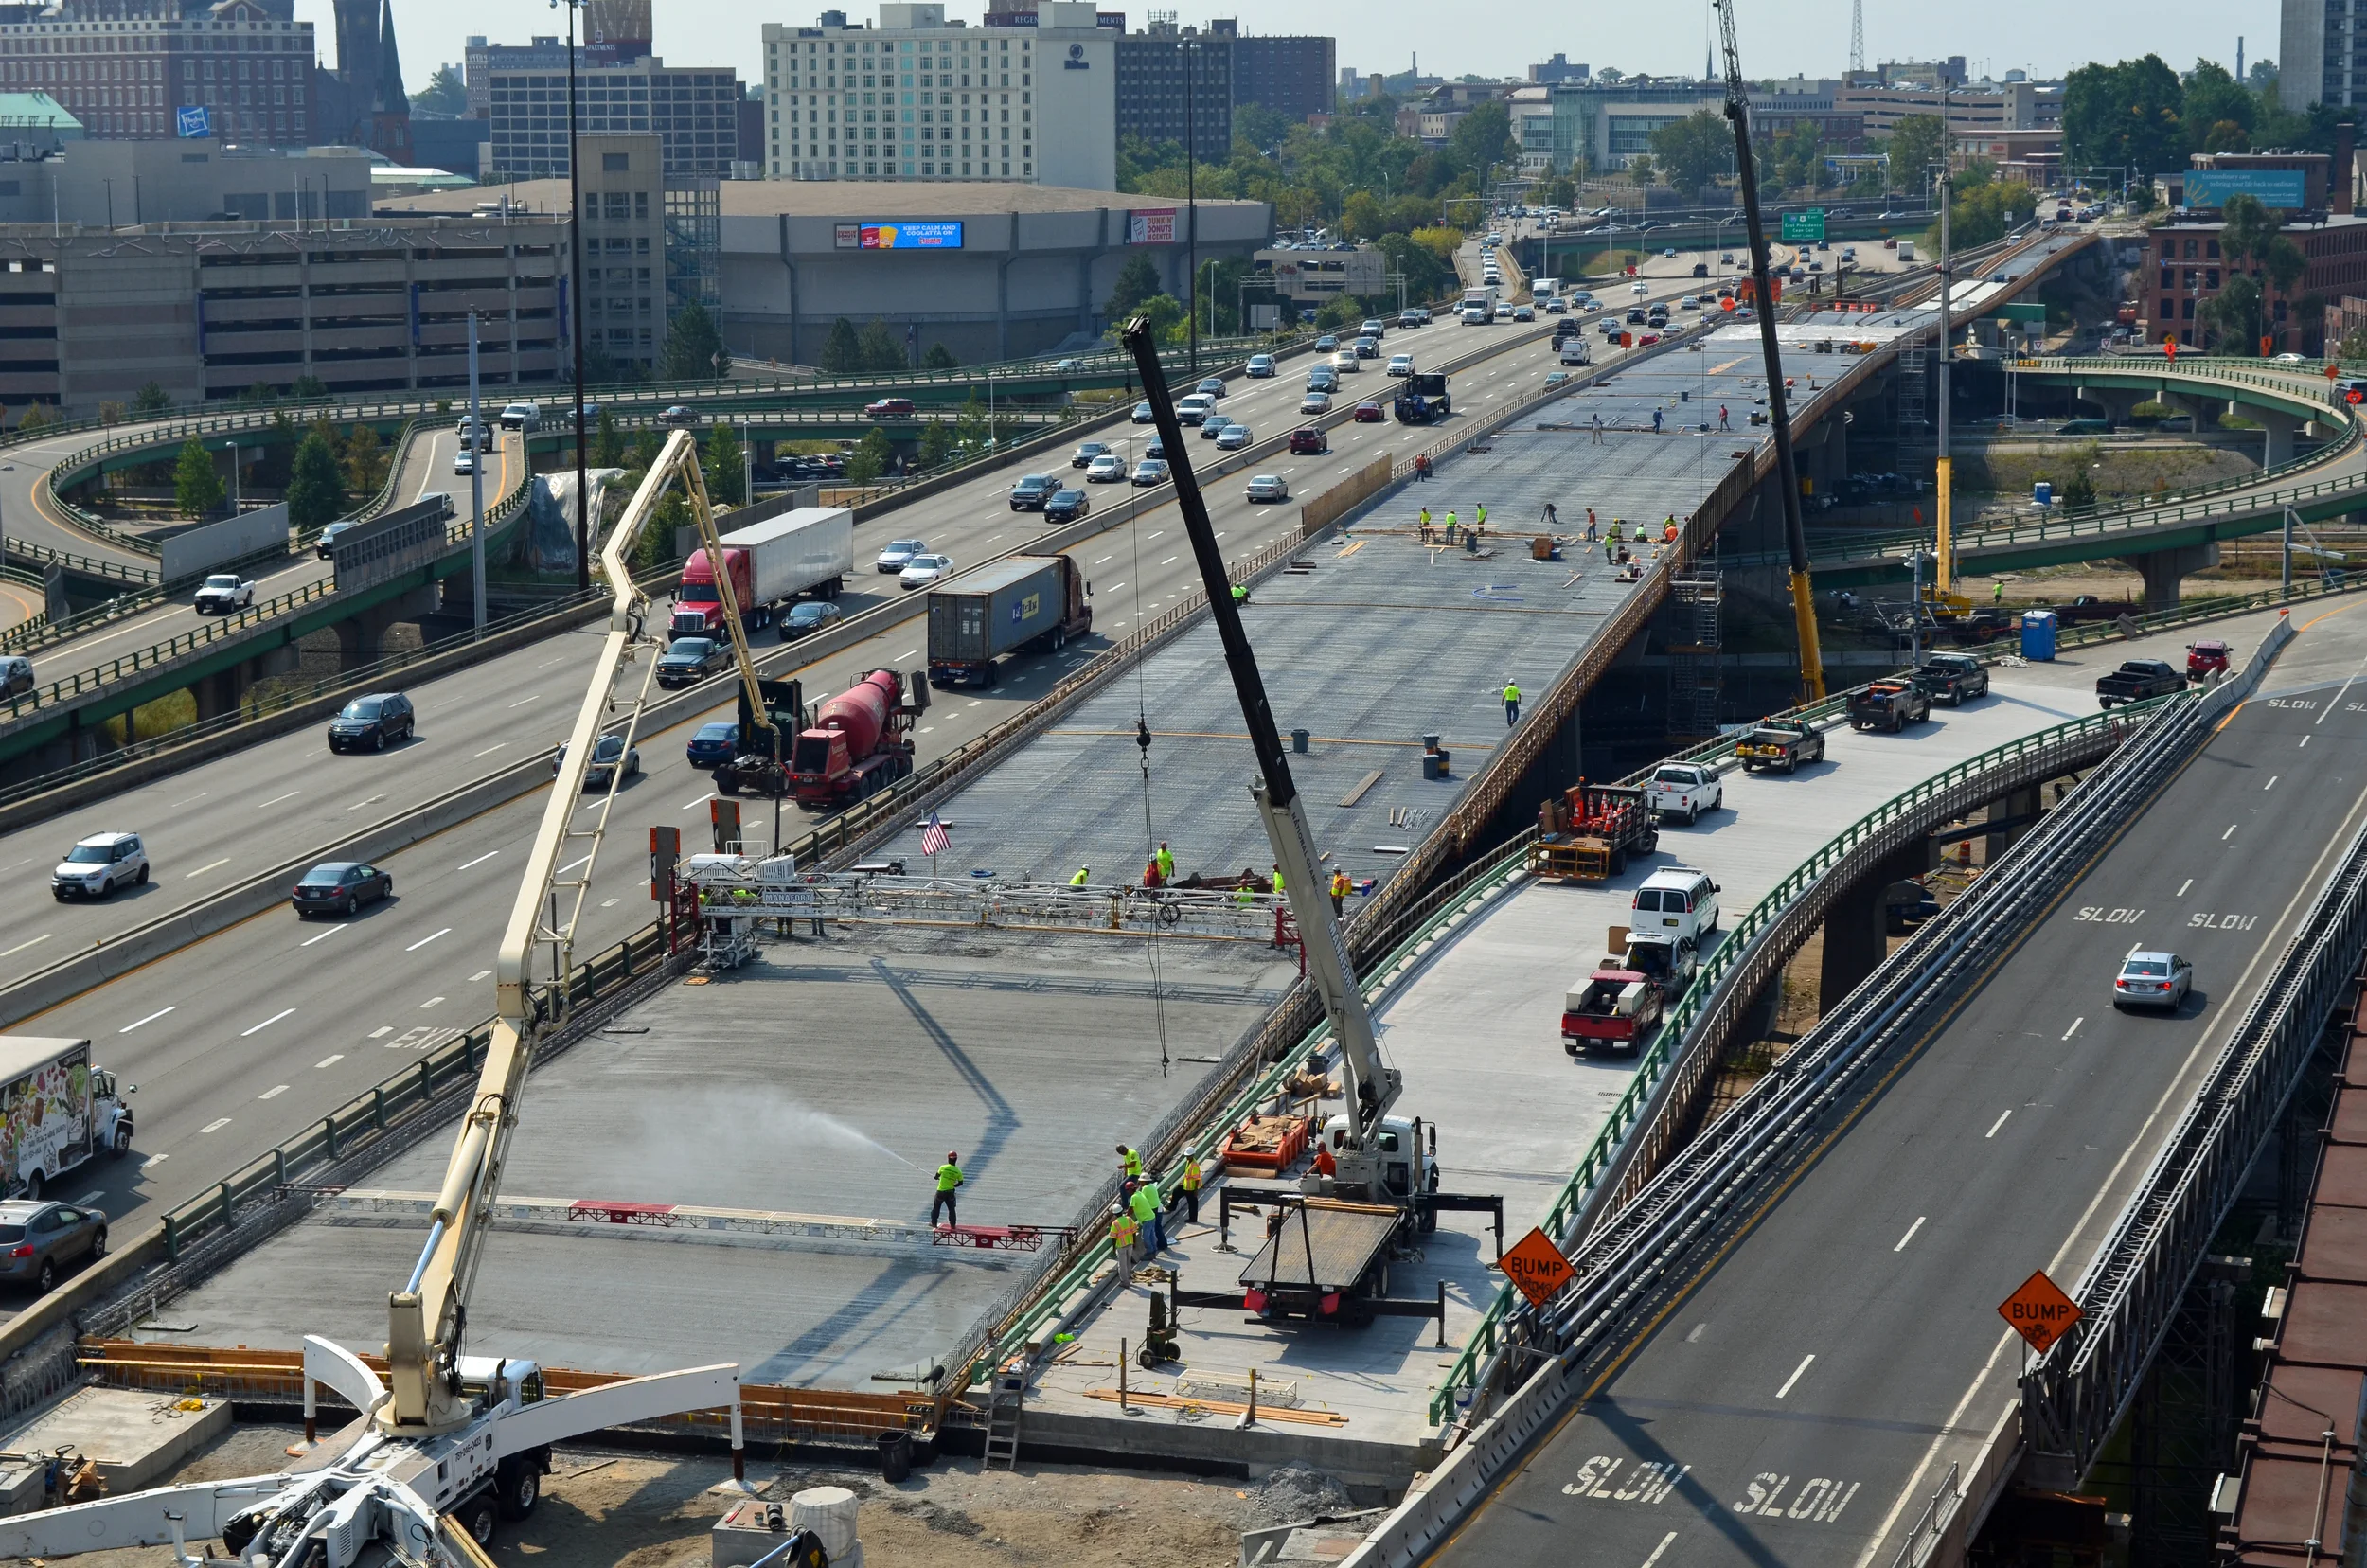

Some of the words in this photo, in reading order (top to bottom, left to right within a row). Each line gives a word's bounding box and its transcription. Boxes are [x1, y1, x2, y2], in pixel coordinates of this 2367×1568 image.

[798, 27, 824, 37] Hilton
[2268, 699, 2317, 709] SLOW
[1291, 812, 1308, 857] NATIONAL
[1306, 857, 1318, 888] CRANE
[765, 893, 811, 901] MANAFORT
[2073, 906, 2145, 924] SLOW
[2187, 913, 2259, 931] SLOW
[1328, 919, 1357, 995] MANAFORT
[1511, 1256, 1563, 1277] BUMP
[2012, 1302, 2070, 1321] BUMP
[1561, 1455, 1692, 1505] SLOW
[1733, 1471, 1861, 1523] SLOW
